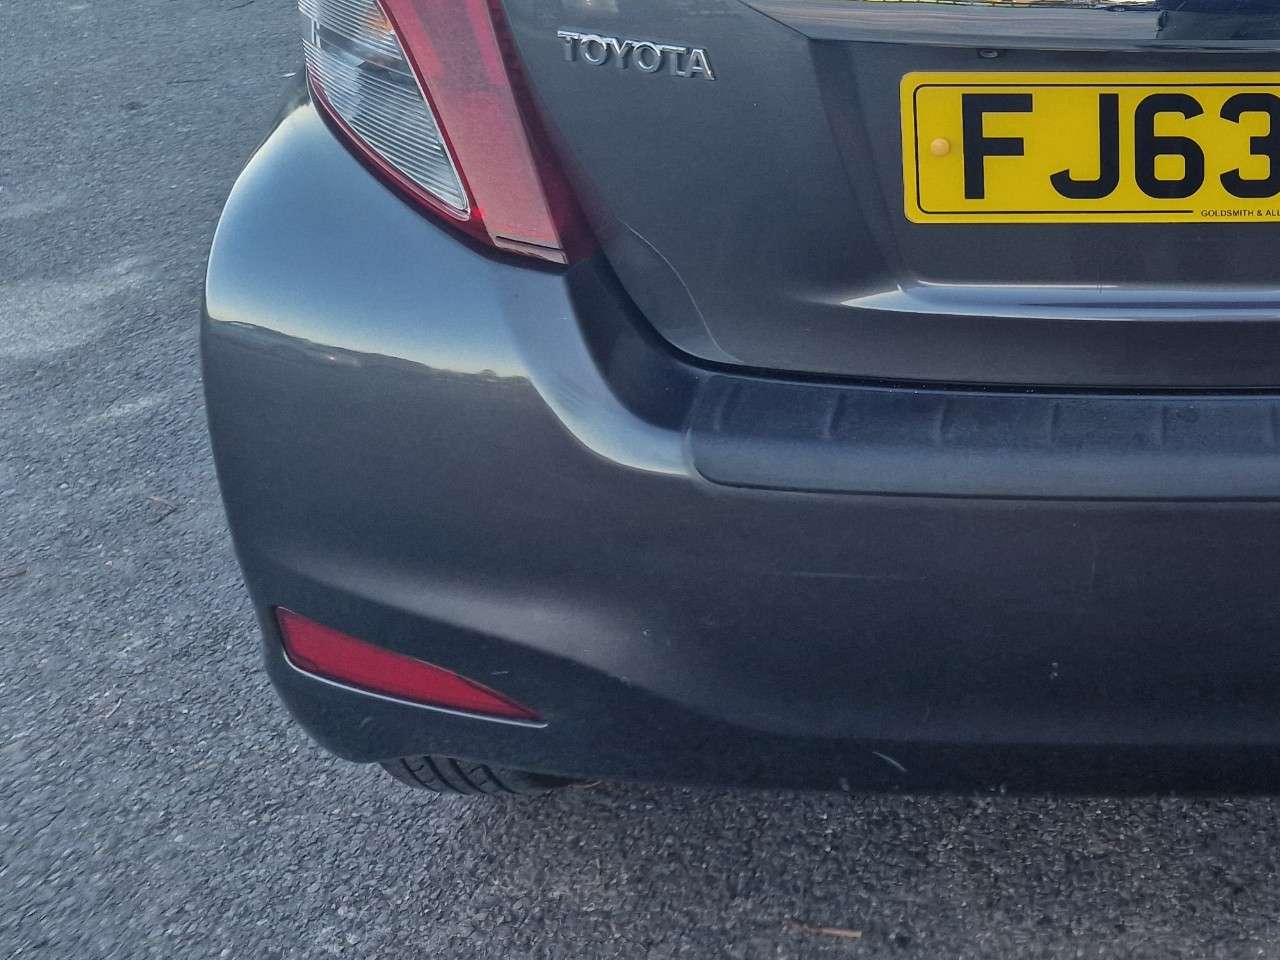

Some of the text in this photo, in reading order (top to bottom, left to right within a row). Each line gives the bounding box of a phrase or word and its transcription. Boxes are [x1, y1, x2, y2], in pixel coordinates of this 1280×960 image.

[557, 30, 715, 80] TOYOTA
[1200, 209, 1254, 217] GOLDSMITH
[1257, 209, 1263, 217] &
